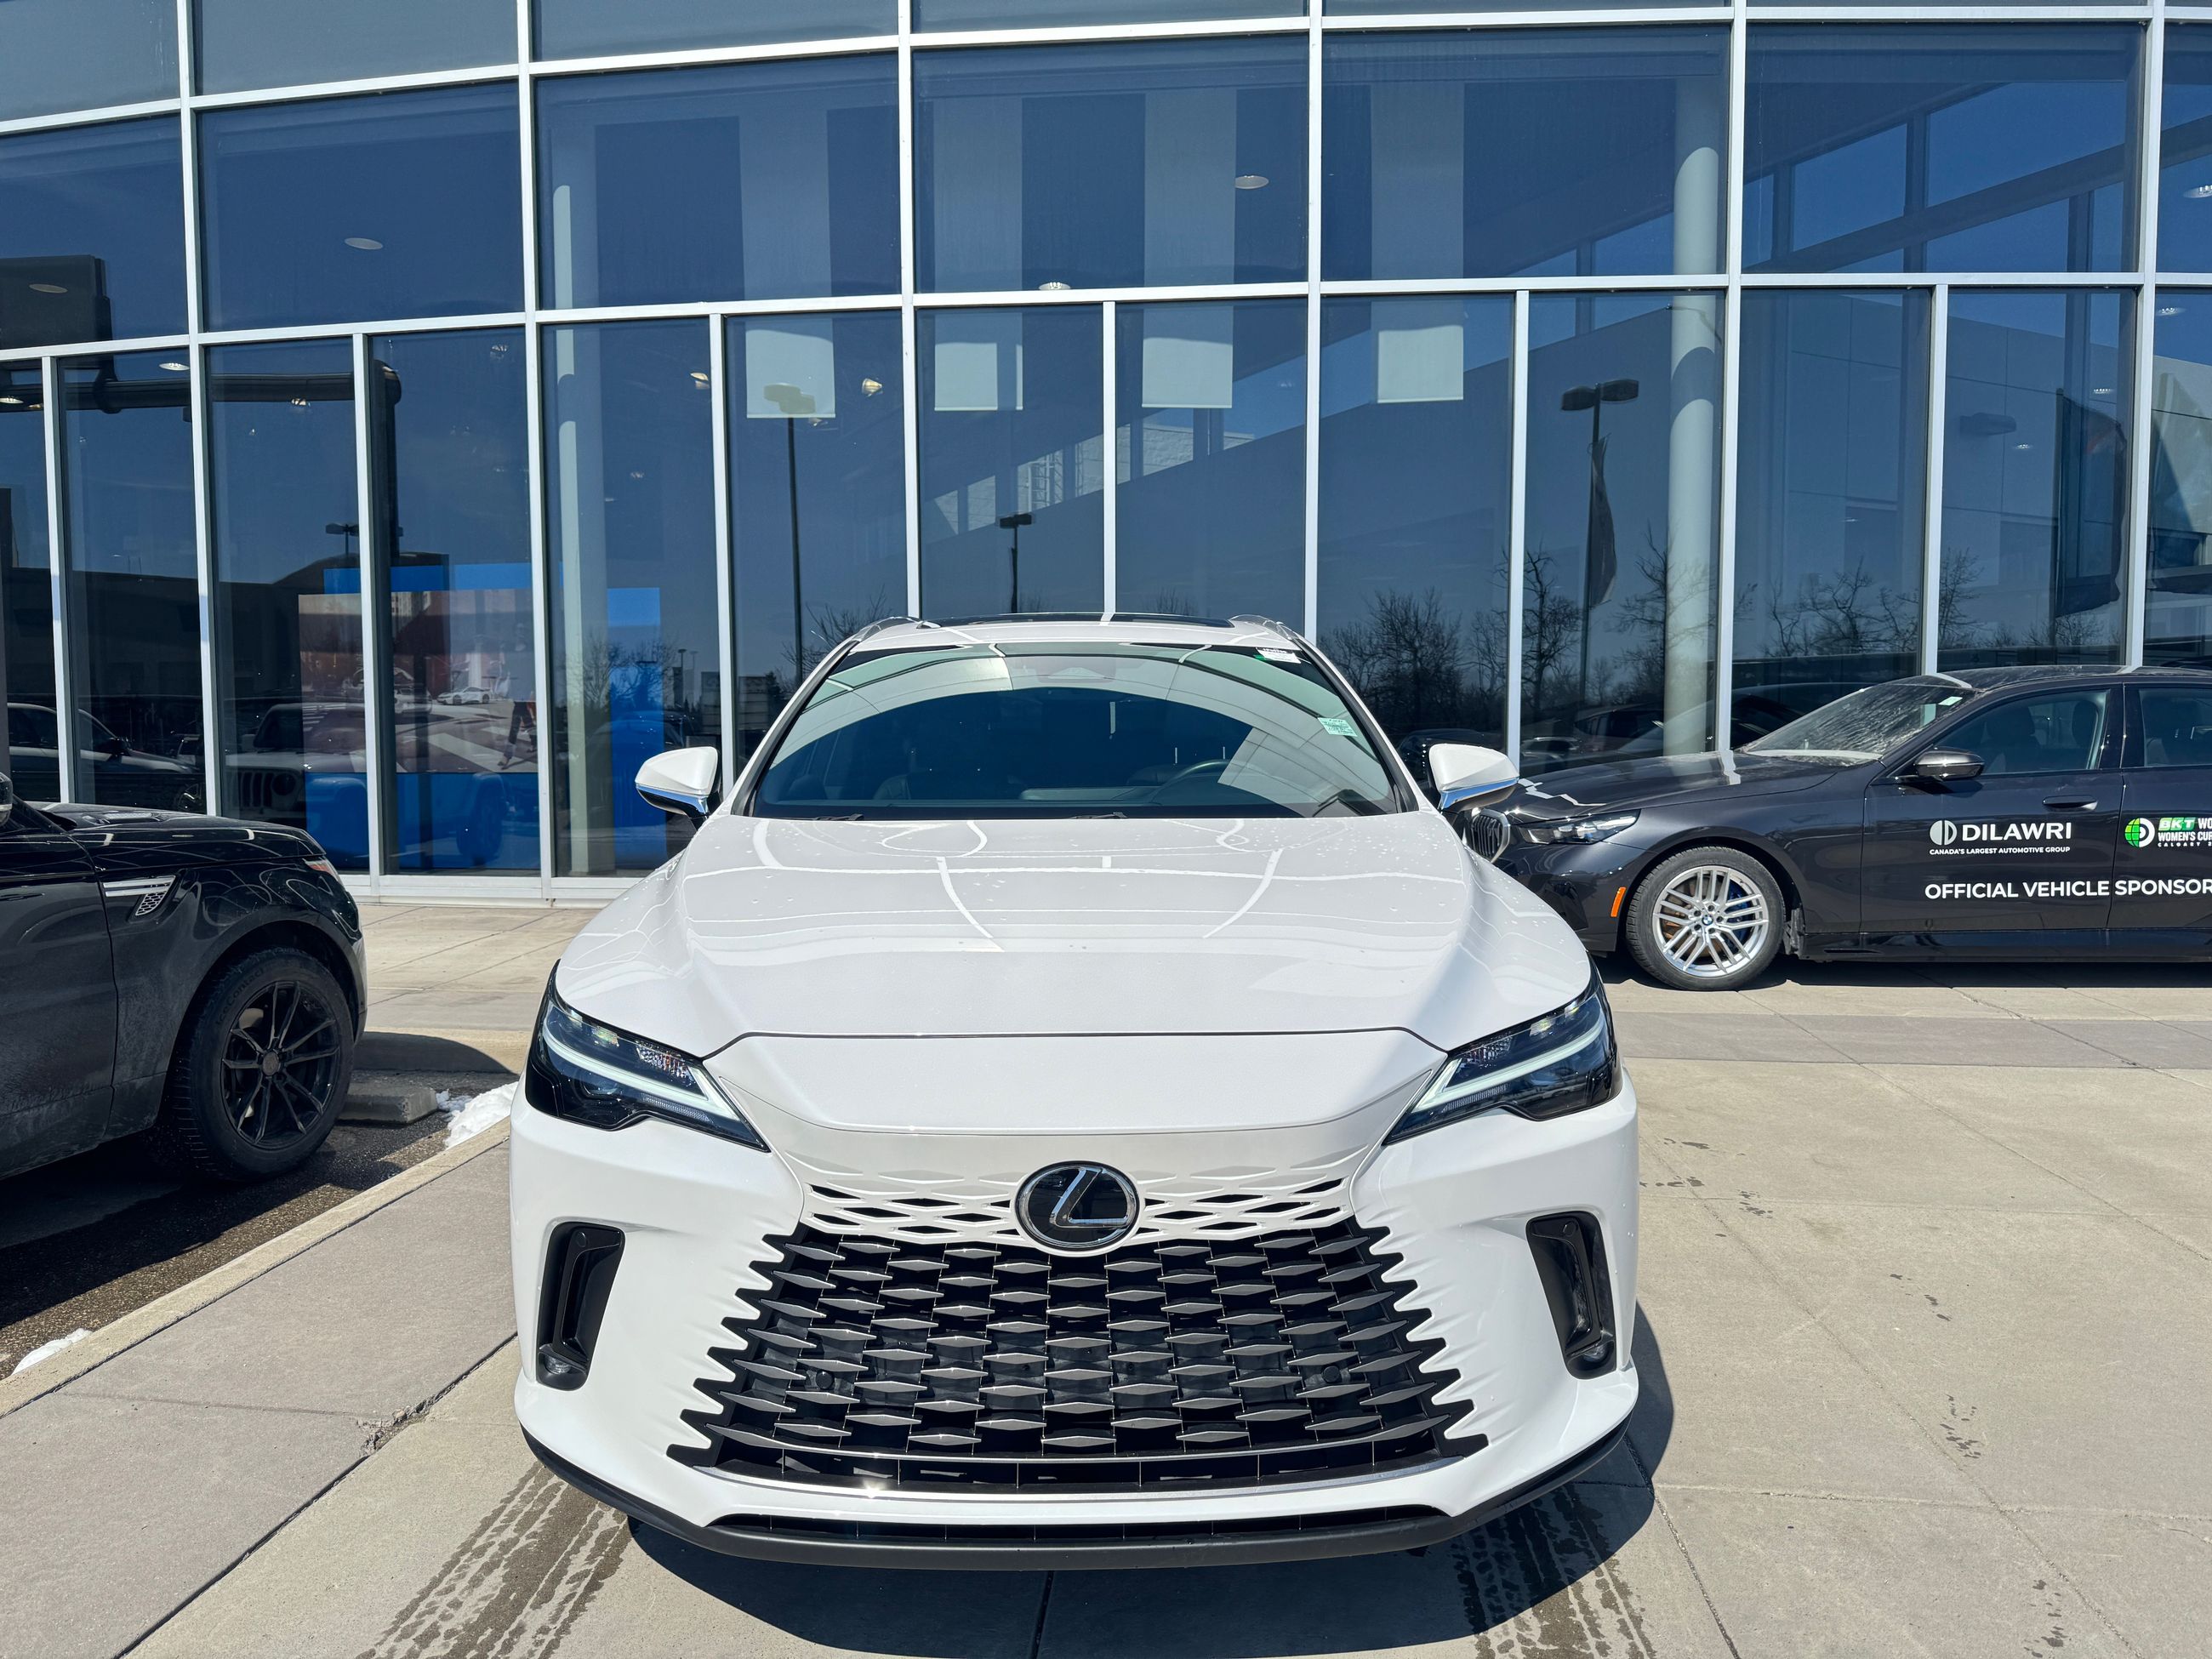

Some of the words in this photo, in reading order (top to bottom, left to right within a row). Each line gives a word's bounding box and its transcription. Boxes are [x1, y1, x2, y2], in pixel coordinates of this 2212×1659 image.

[1962, 822, 2072, 841] DILAWRI
[2158, 818, 2196, 831] BKT
[2158, 831, 2196, 841] WOMEN'S
[1924, 882, 2020, 899] OFFICIAL
[2022, 881, 2110, 898] VEHICLE
[2114, 878, 2212, 896] SPONSOR
